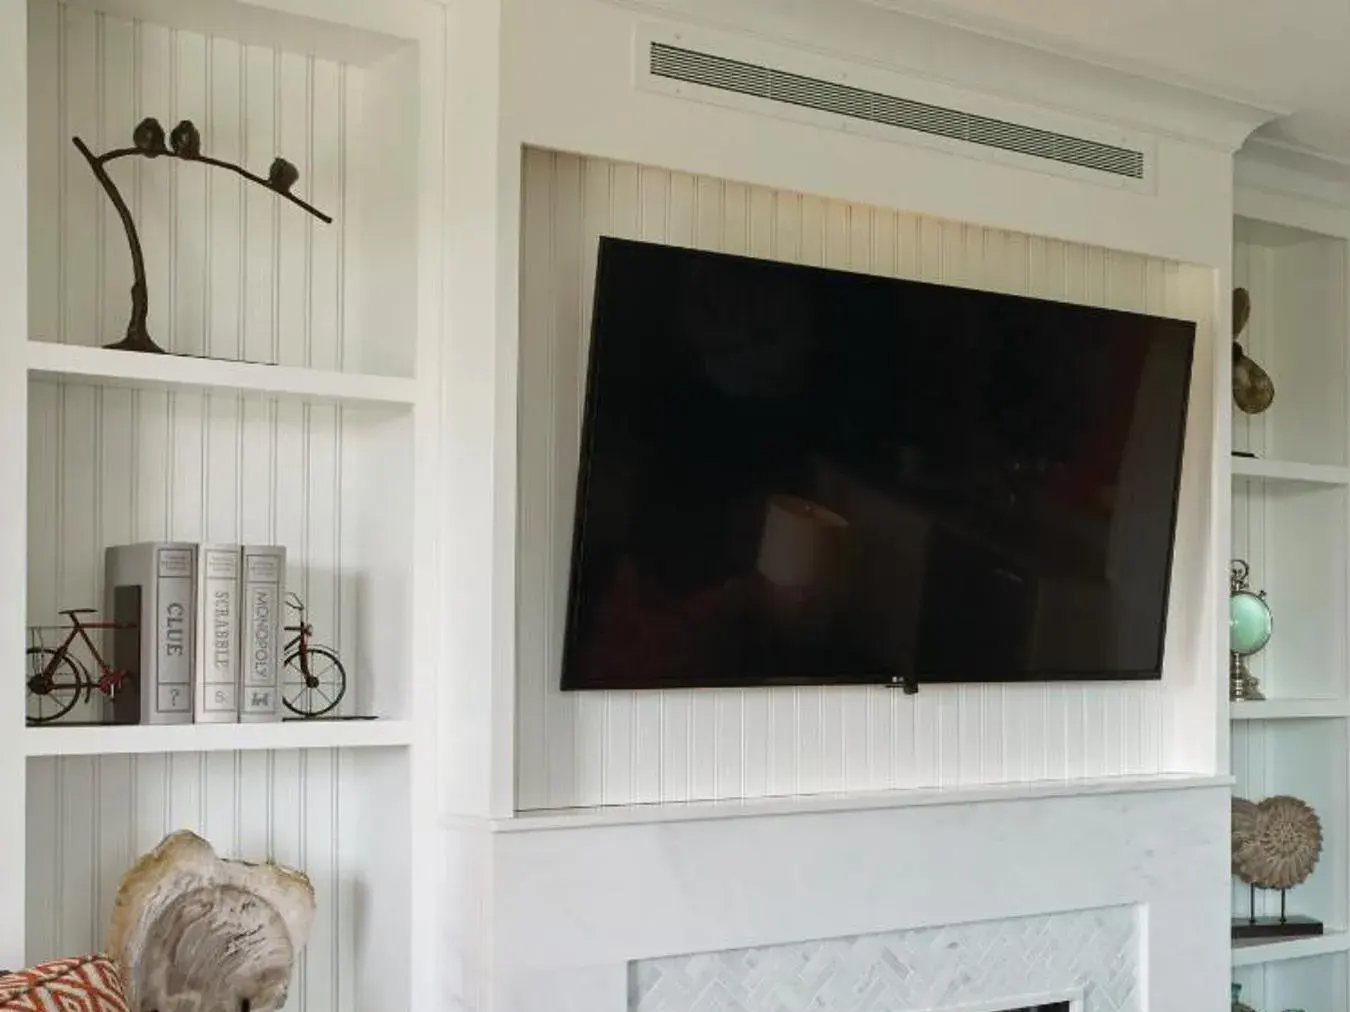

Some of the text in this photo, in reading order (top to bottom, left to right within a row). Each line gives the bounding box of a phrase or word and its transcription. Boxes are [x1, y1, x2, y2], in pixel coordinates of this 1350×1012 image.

[167, 603, 184, 657] CLUE
[214, 591, 230, 671] SCRABBLE
[254, 591, 270, 678] MONOPOLY
